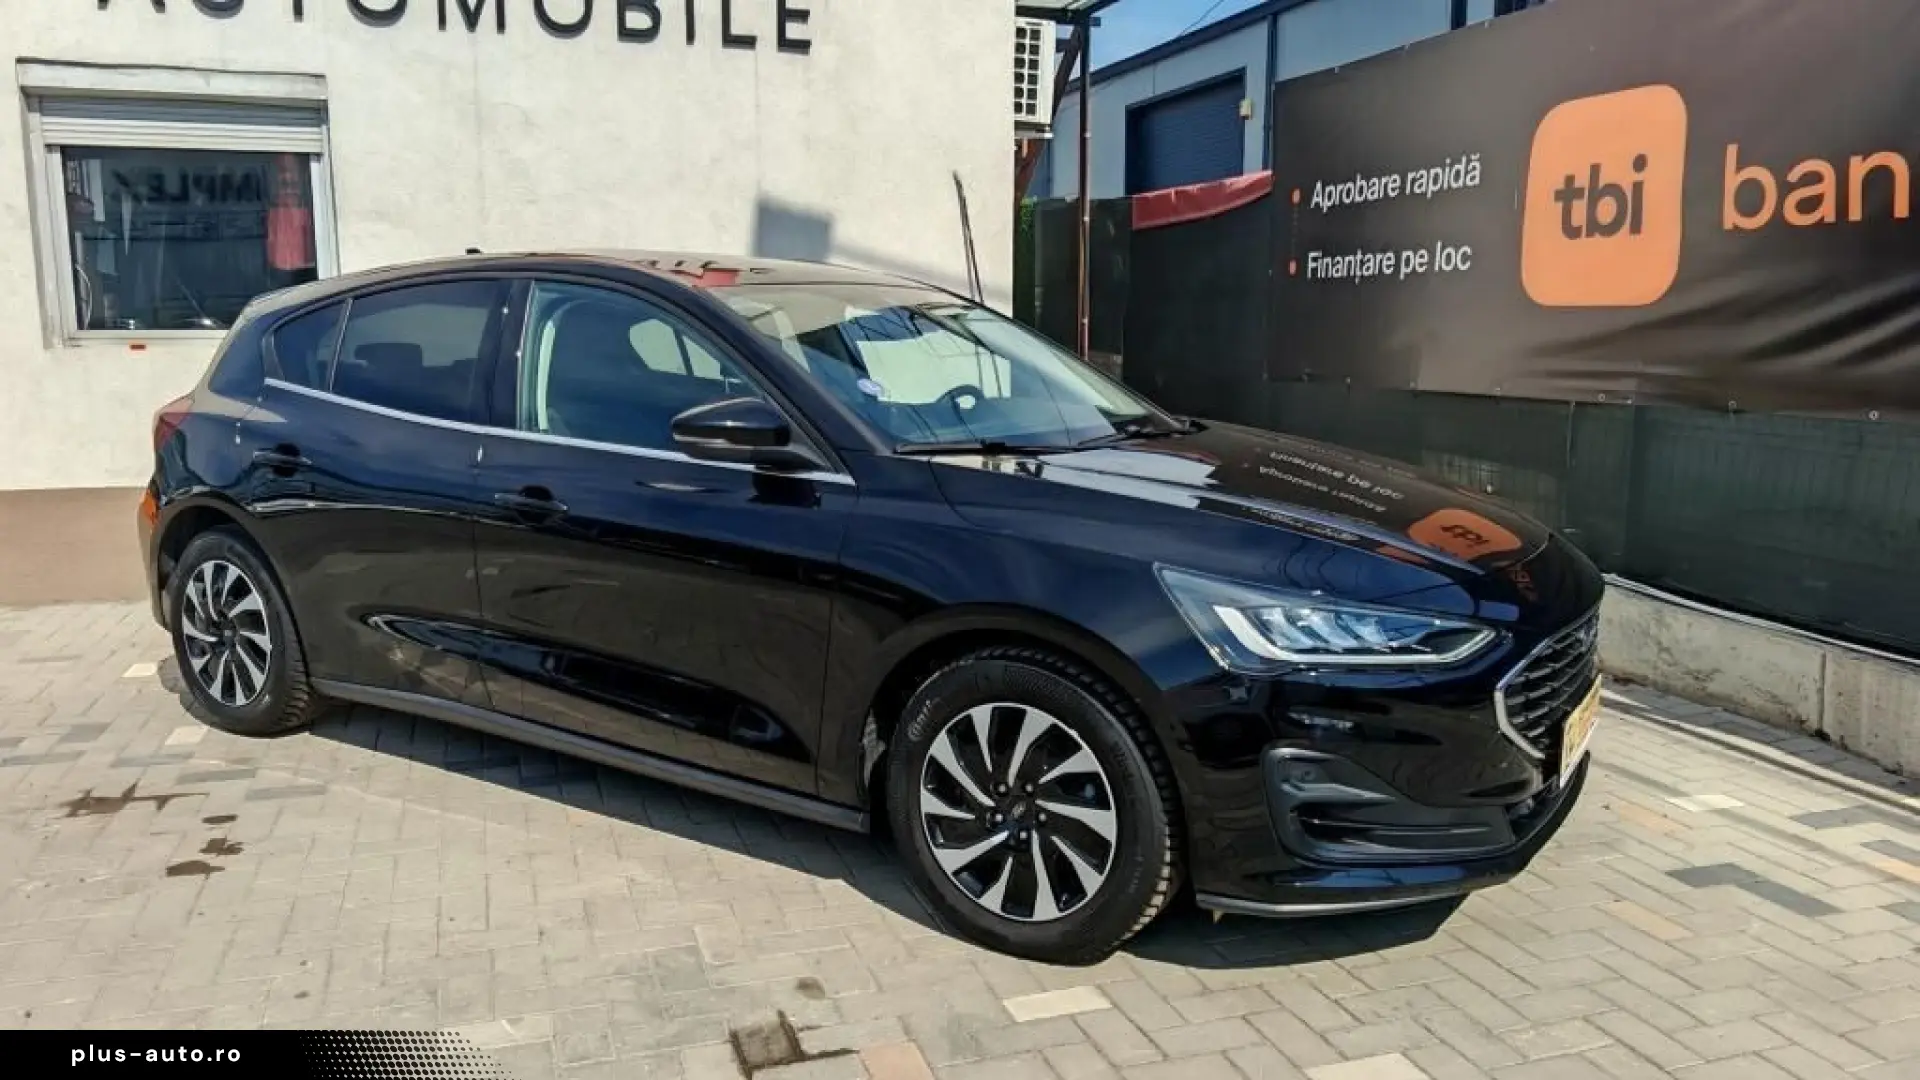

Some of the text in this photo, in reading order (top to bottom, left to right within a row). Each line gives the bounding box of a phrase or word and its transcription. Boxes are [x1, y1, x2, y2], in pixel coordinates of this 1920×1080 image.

[97, 0, 812, 54] MOBILE
[1310, 152, 1481, 213] Aprobare rapidă
[1553, 143, 1910, 241] tbi ban
[1307, 240, 1473, 285] Finanțare pe loc
